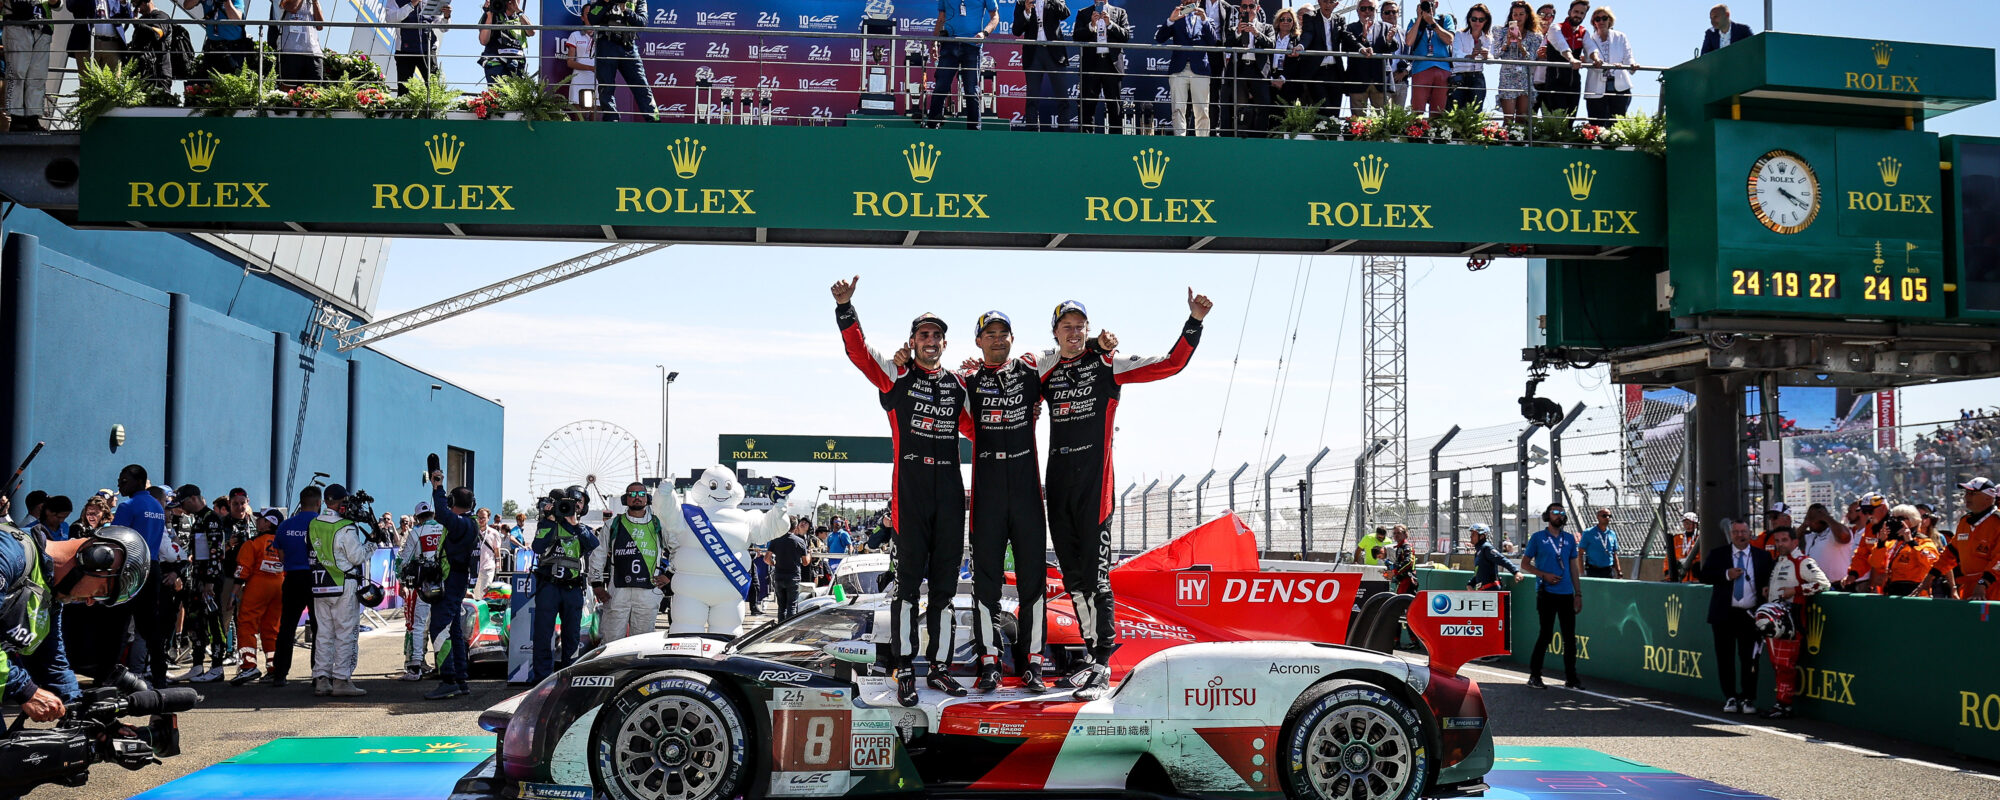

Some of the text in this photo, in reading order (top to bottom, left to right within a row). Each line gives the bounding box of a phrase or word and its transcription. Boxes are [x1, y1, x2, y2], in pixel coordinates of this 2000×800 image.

[697, 12, 737, 22] 10 WEC
[799, 15, 839, 24] 10 WEC
[900, 19, 909, 28] 10
[646, 42, 686, 51] 10 WEC
[749, 45, 758, 55] 10
[799, 78, 839, 88] 10 WEC
[1846, 72, 1920, 93] ROLEX
[1770, 176, 1795, 184] ROLEX
[128, 181, 271, 208] ROLEX
[372, 183, 516, 210] ROLEX
[616, 187, 756, 215] ROLEX
[854, 191, 990, 219] ROLEX
[1848, 191, 1934, 214] ROLEX
[1085, 196, 1217, 224] ROLEX
[1308, 201, 1434, 229] ROLEX
[1520, 207, 1640, 234] ROLEX
[1809, 273, 1836, 298] 27
[1864, 275, 1890, 301] 24
[1901, 277, 1927, 302] 05
[1053, 386, 1093, 400] DENSO
[982, 394, 1024, 407] DENSO
[914, 402, 954, 417] DENSO
[1053, 407, 1070, 416] GR
[910, 419, 933, 431] GR
[981, 414, 1002, 423] GR
[732, 451, 768, 459] ROLEX
[813, 452, 848, 460] ROLEX
[690, 515, 749, 587] MICHELIN
[631, 559, 641, 574] 6
[1097, 530, 1111, 593] DENSO
[312, 570, 326, 584] 17
[518, 580, 531, 592] P2
[1178, 579, 1206, 600] HY
[1221, 578, 1340, 603] DENSO
[1454, 600, 1494, 612] JFE
[1119, 619, 1189, 633] RACING
[1442, 624, 1483, 636] ADVICS
[703, 643, 711, 651] 8
[838, 646, 859, 655] Mobil
[1268, 662, 1320, 674] Acronis
[1643, 645, 1703, 679] ROLEX
[573, 677, 613, 687] AISIN
[758, 670, 812, 682] RAYS
[1797, 664, 1857, 706] OLEX
[782, 689, 804, 702] 24h
[1184, 684, 1256, 712] FUJITSU
[978, 726, 999, 736] GR
[69, 741, 86, 749] SONY
[803, 716, 834, 765] 8
[854, 737, 891, 748] HYPER
[854, 748, 891, 766] CAR
[790, 773, 832, 784] WEC
[537, 789, 586, 798] MICHELIN
